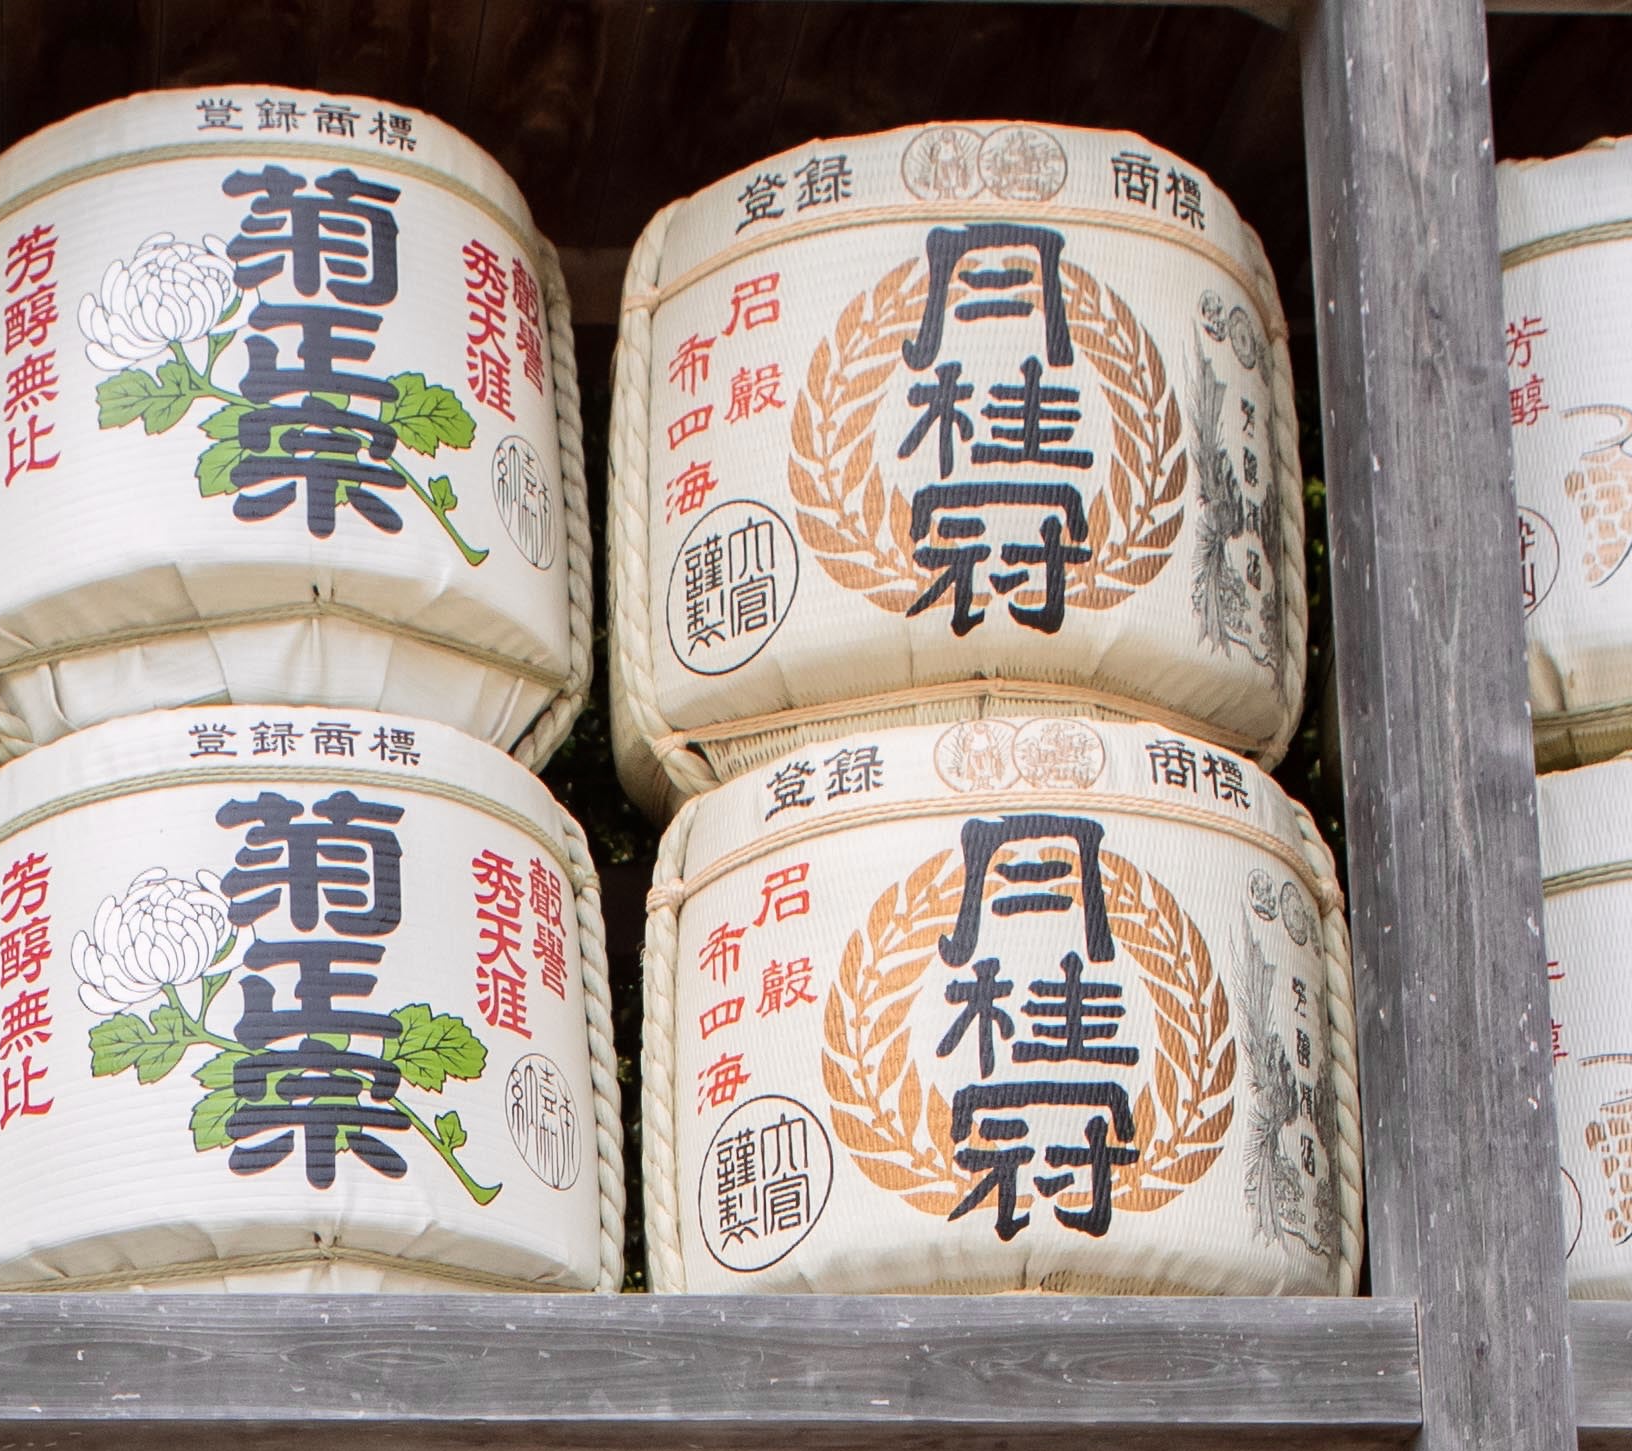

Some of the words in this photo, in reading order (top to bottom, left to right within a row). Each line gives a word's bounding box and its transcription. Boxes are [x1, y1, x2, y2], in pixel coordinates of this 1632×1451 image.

[3, 224, 60, 488] 芳醇無比
[220, 166, 406, 539] 菊正宗
[736, 154, 853, 234] 登録
[1111, 151, 1206, 229] 商標
[898, 223, 1094, 637] 月桂冠
[763, 746, 884, 822] 登録
[1145, 739, 1251, 811] 商標
[214, 790, 409, 1190] 菊正宗
[934, 813, 1140, 1241] 月桂冠
